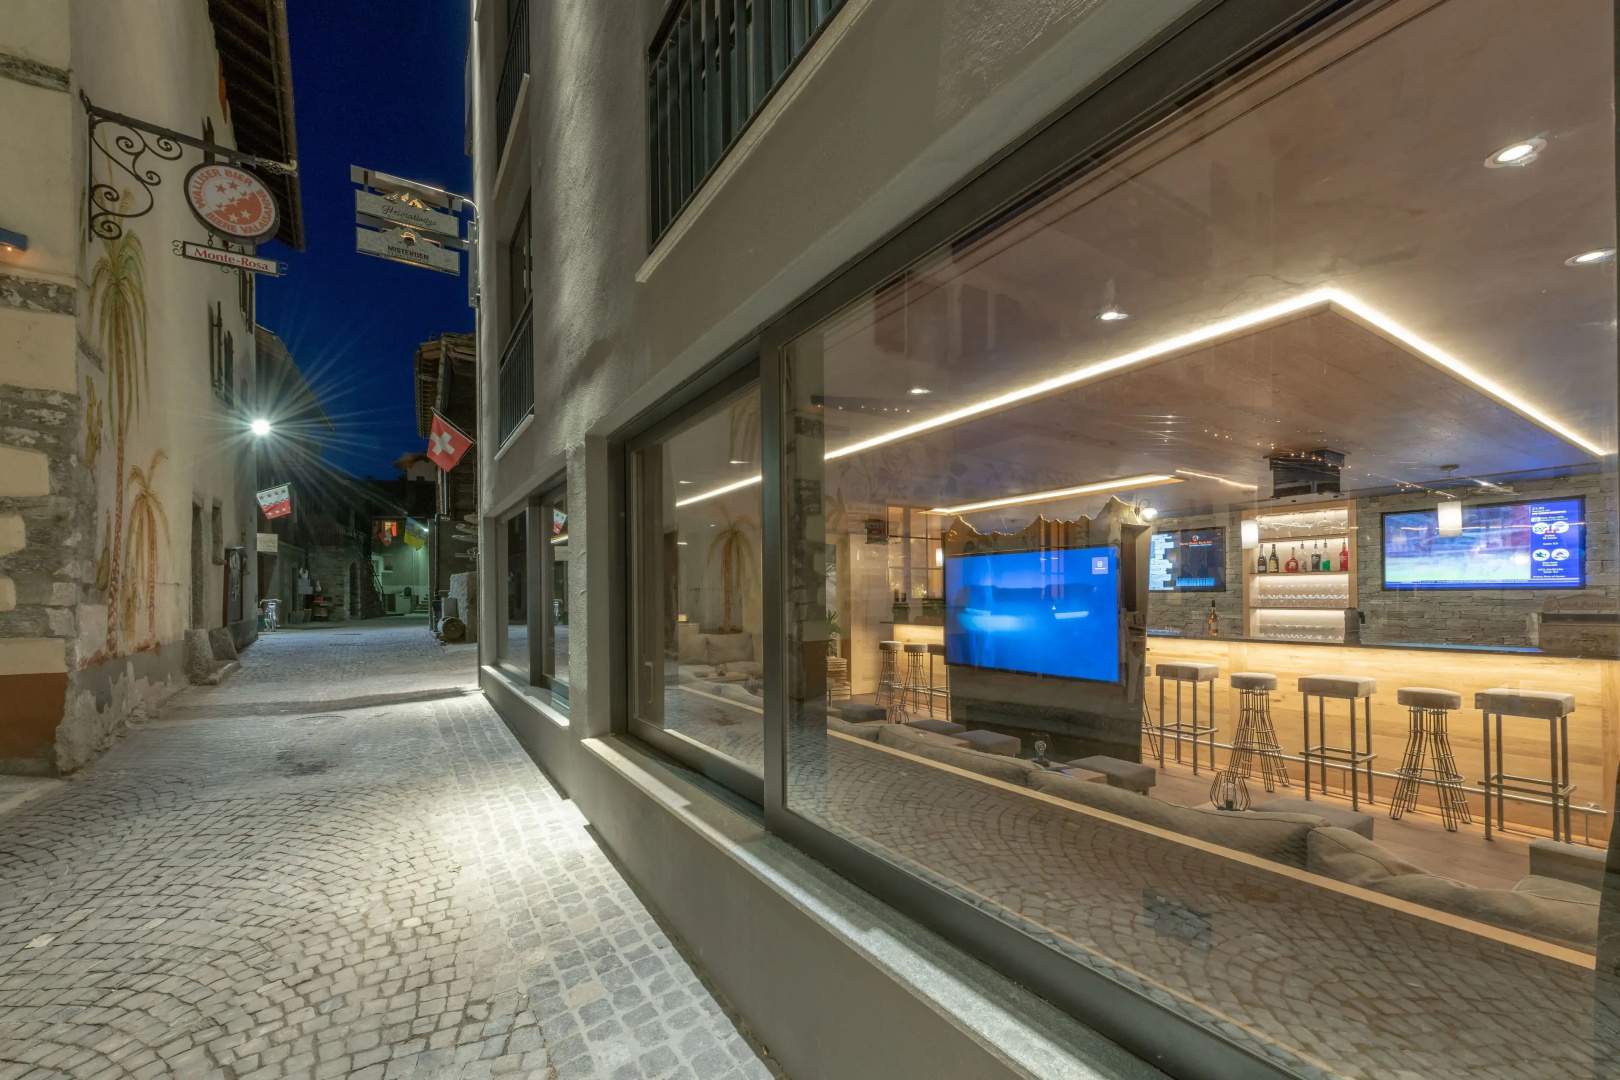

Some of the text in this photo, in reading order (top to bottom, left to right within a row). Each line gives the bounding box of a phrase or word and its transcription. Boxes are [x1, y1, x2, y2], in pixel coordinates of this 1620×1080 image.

[192, 168, 253, 209] WALLISER BIER
[239, 188, 273, 234] VALAISANNE
[194, 247, 269, 271] Monte-Rosa
